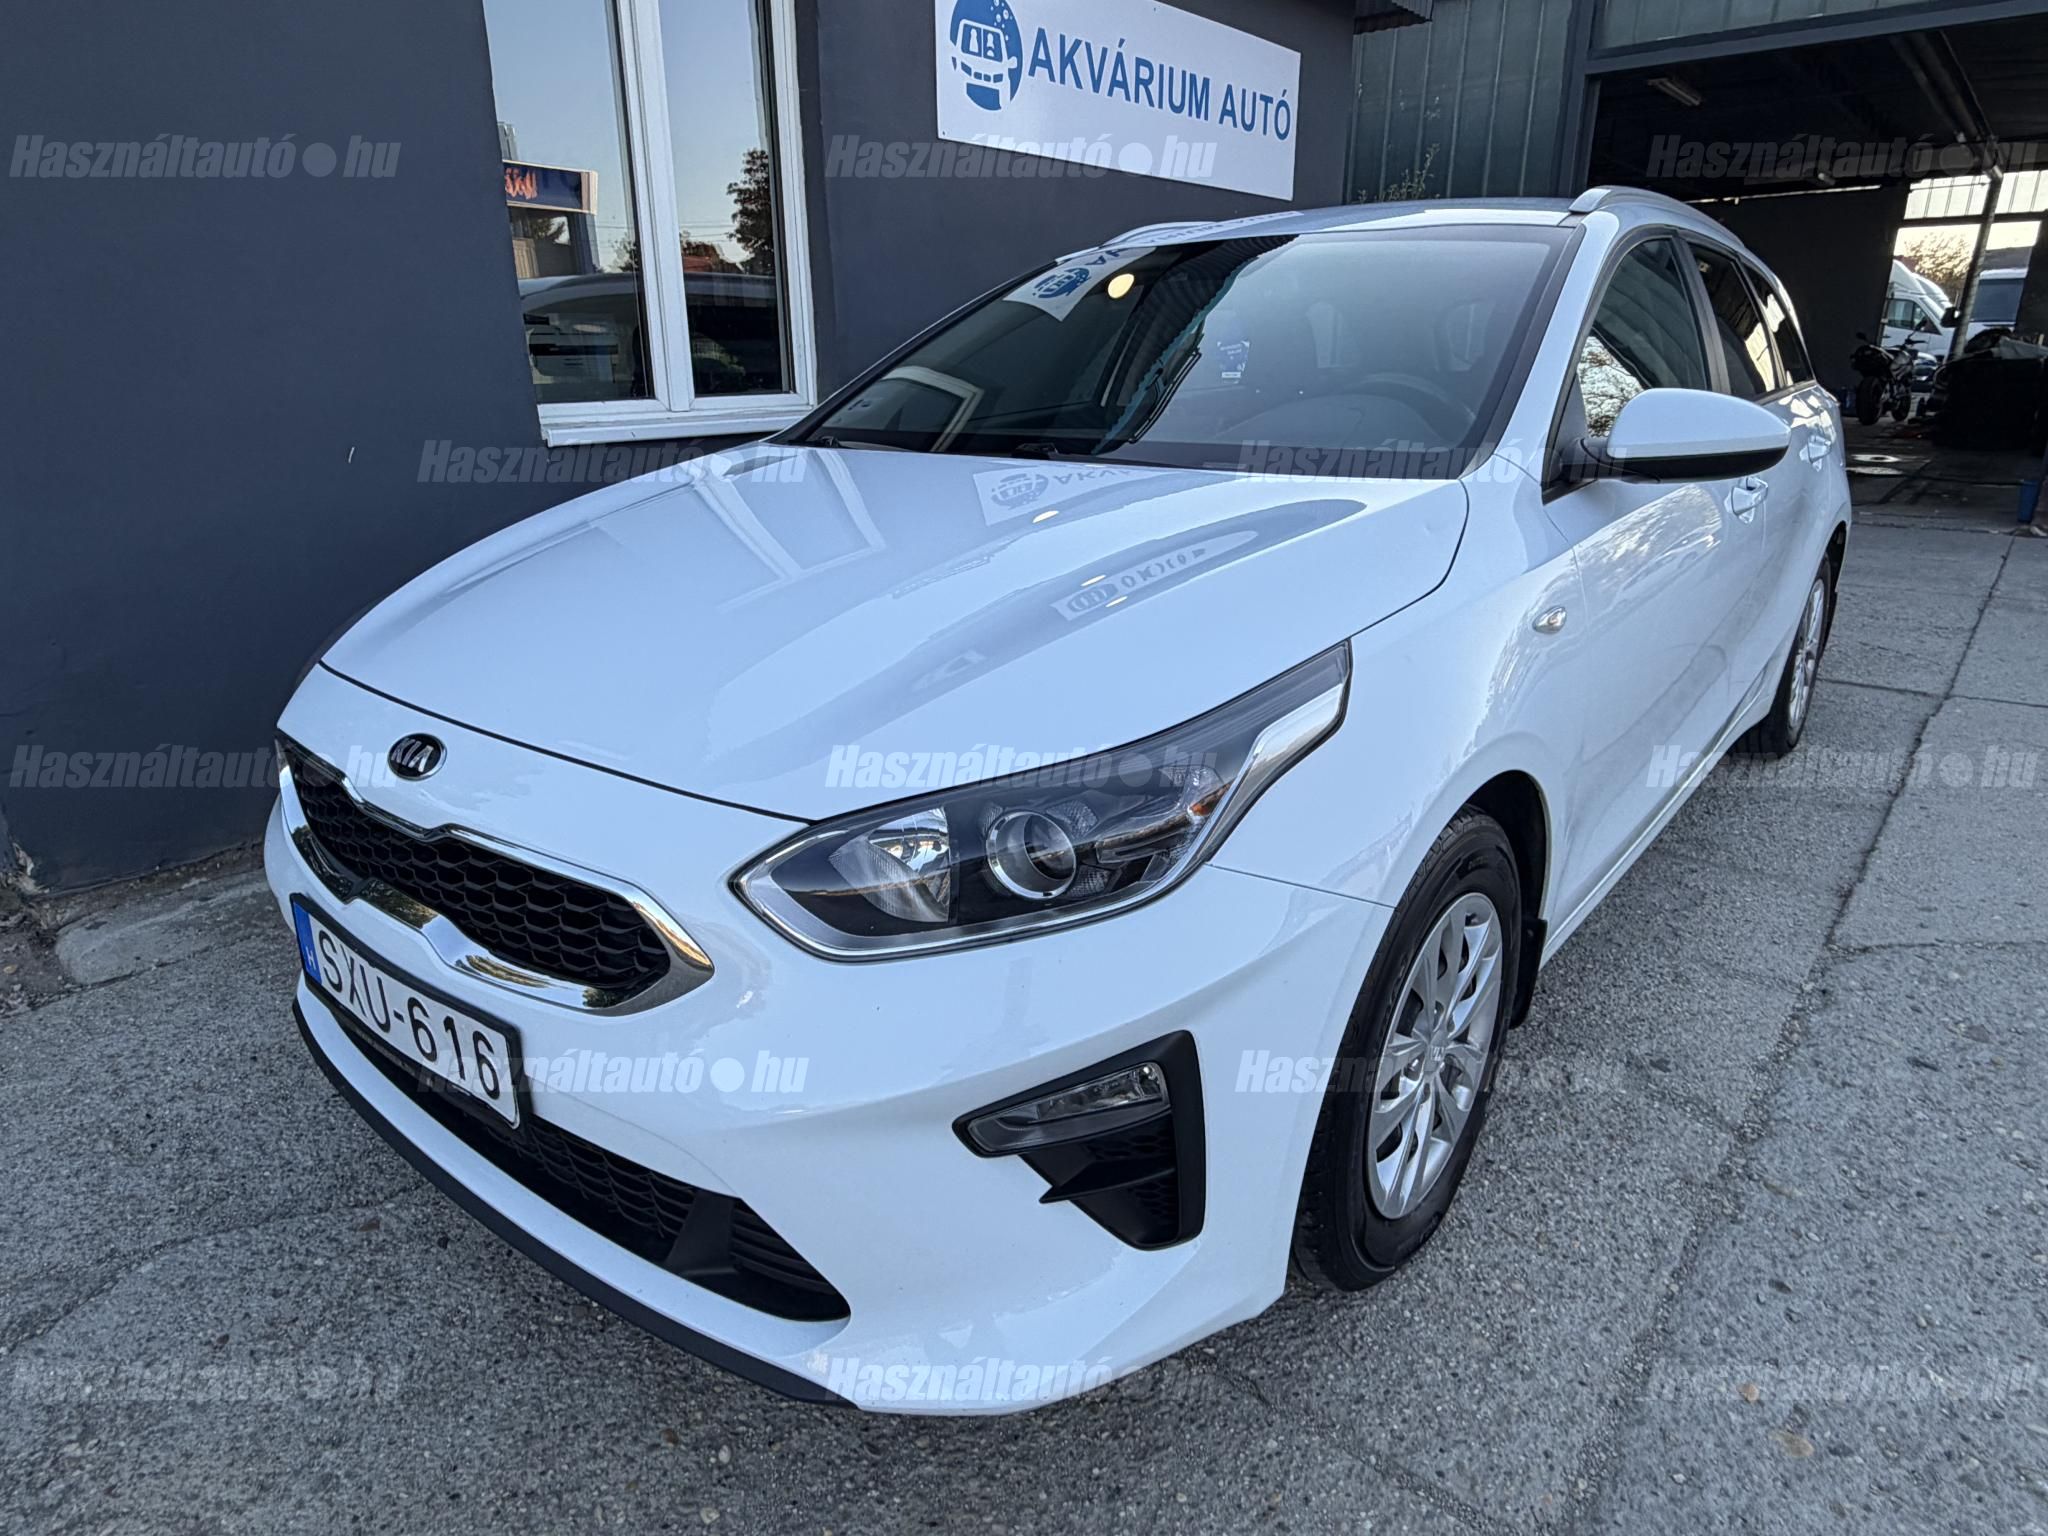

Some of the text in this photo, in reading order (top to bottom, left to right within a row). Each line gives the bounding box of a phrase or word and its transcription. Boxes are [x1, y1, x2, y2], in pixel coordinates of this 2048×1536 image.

[1028, 27, 1292, 141] AKVÁRIUM AUTÓ
[391, 738, 434, 772] KIA
[303, 946, 316, 971] H
[318, 930, 501, 1101] SXU-616
